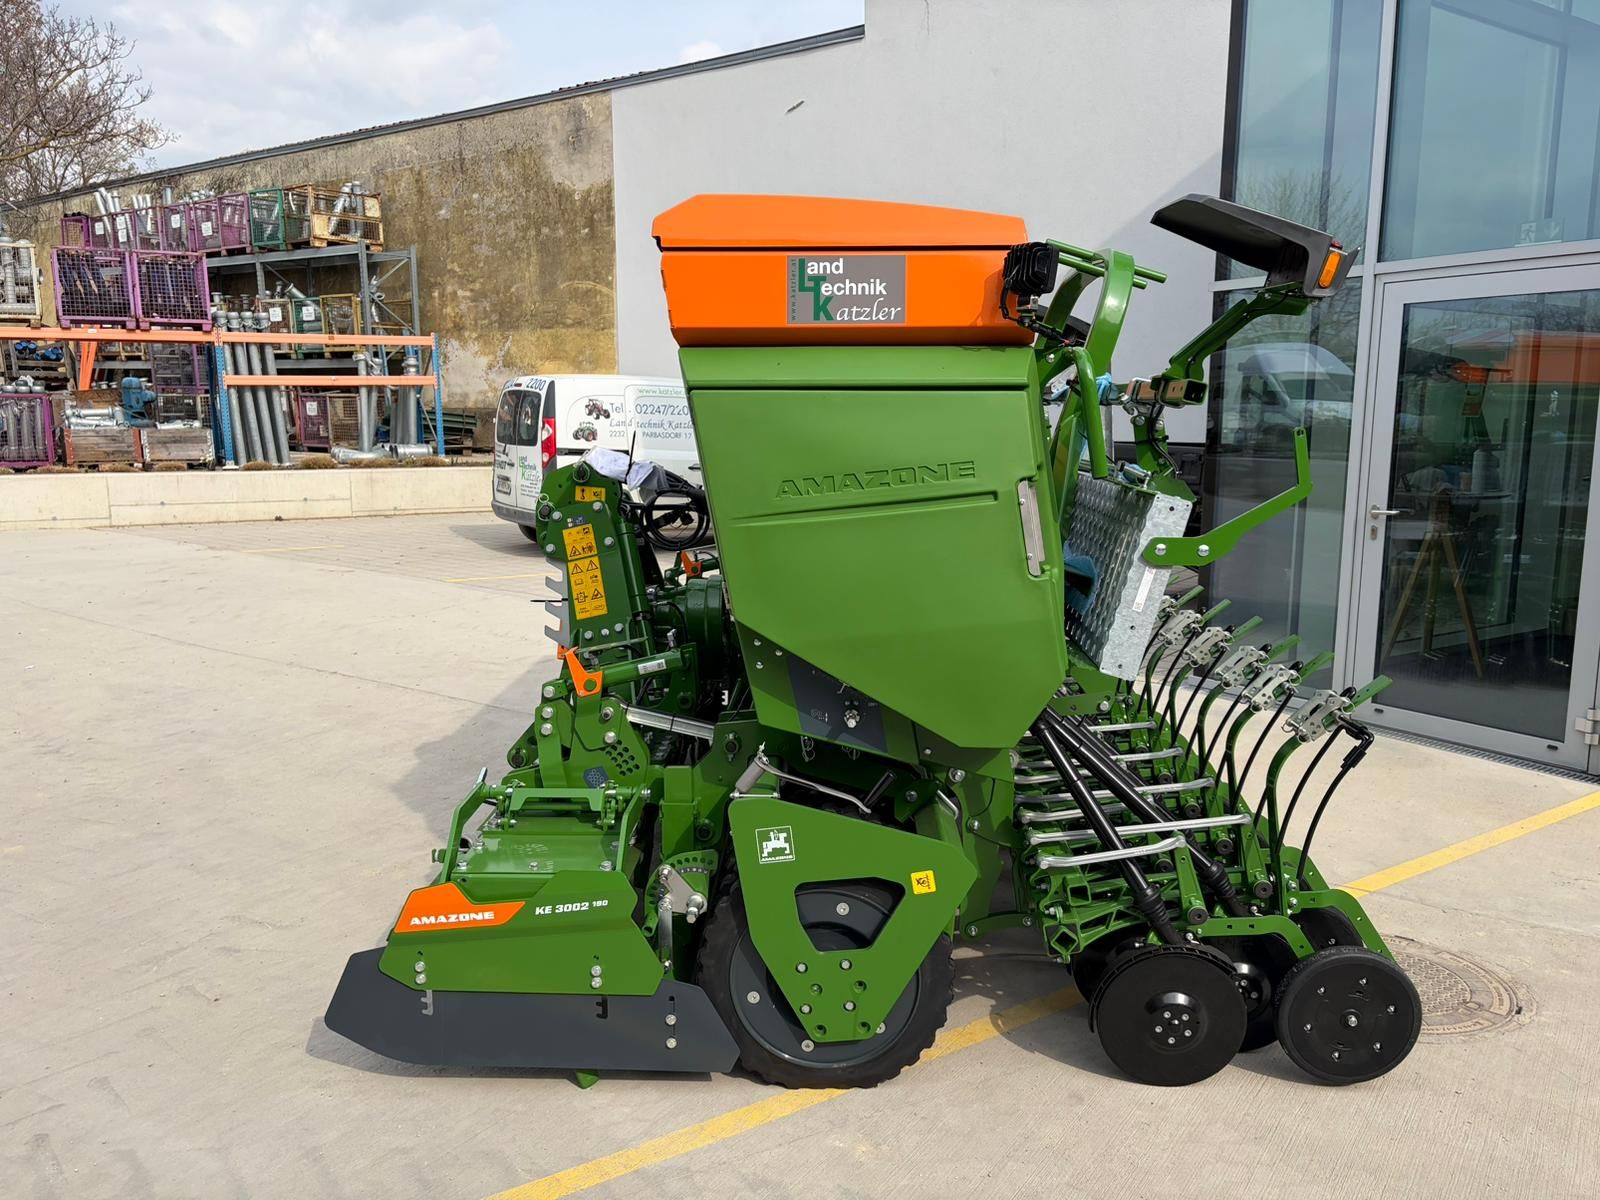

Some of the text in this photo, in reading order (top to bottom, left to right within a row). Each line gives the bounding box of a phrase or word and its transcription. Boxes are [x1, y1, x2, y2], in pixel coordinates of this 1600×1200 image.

[798, 258, 844, 293] Land
[807, 275, 888, 297] Technik
[813, 296, 902, 321] Katzler
[776, 460, 976, 499] AMAZONE
[409, 911, 495, 926] AMAZONE
[535, 905, 553, 915] KE
[555, 902, 590, 913] 3002
